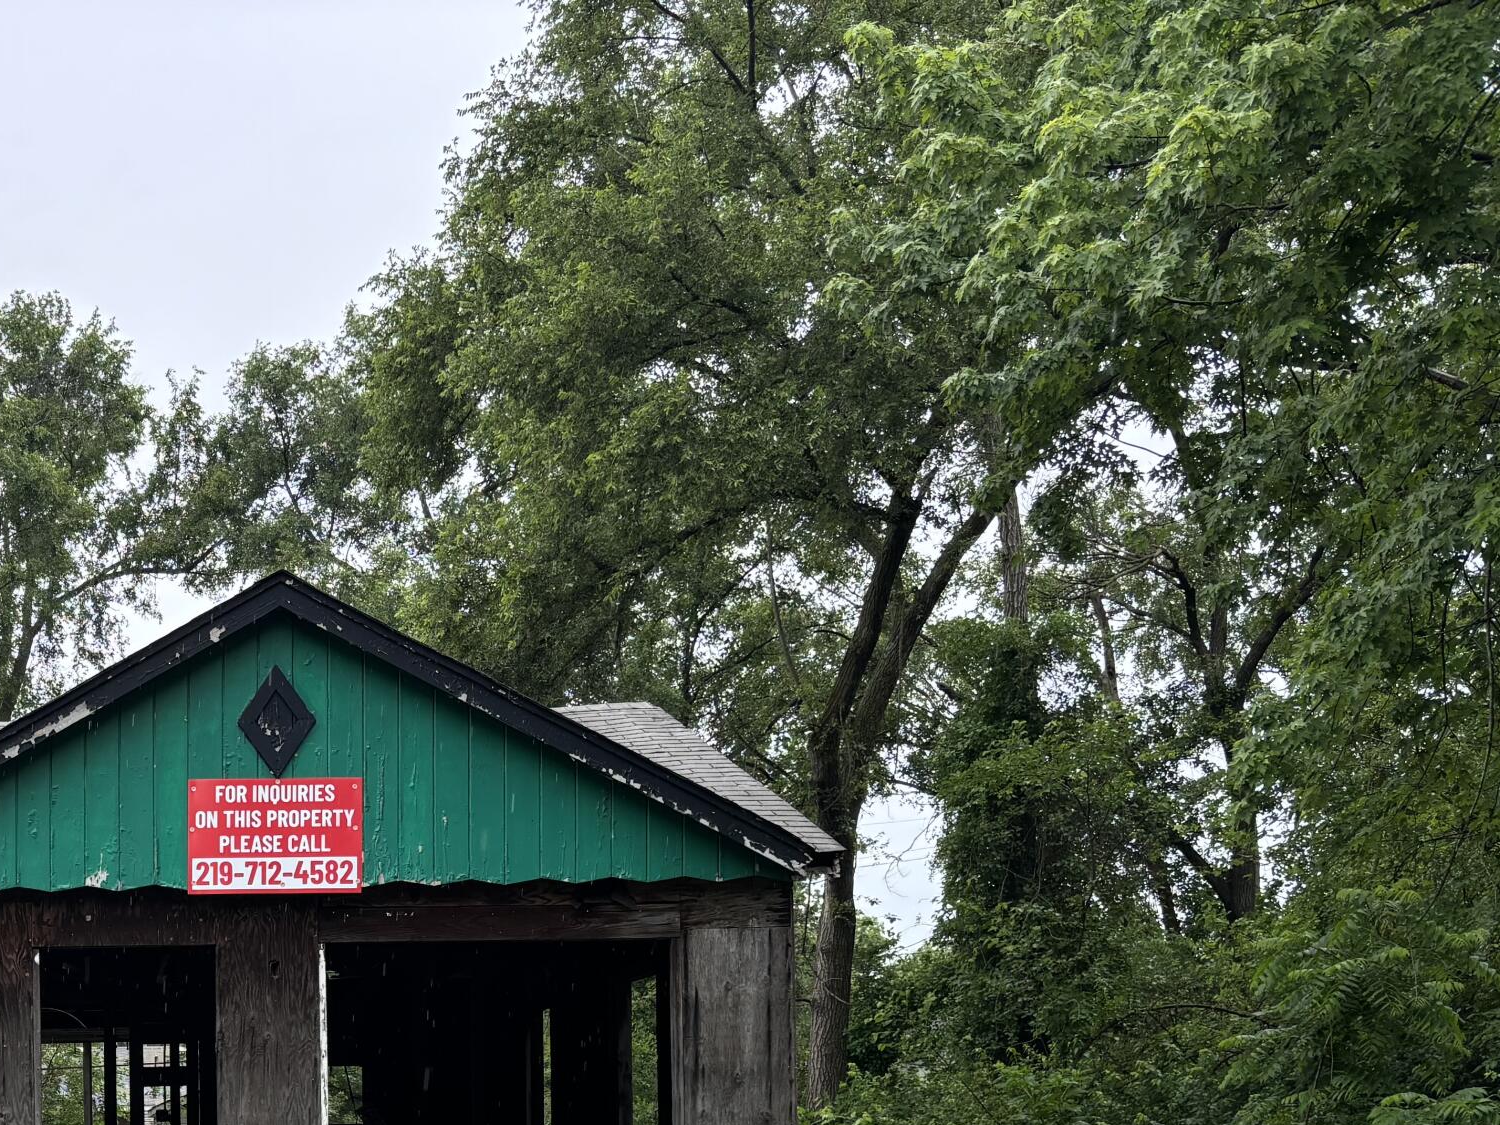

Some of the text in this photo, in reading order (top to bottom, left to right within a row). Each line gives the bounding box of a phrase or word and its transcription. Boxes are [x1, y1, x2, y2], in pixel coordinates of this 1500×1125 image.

[215, 784, 335, 805] FOR INQUIRIES
[195, 809, 355, 828] ON THIS PROPERTY
[219, 834, 331, 853] PLEASE CALL
[195, 860, 354, 885] 219-712-4582
